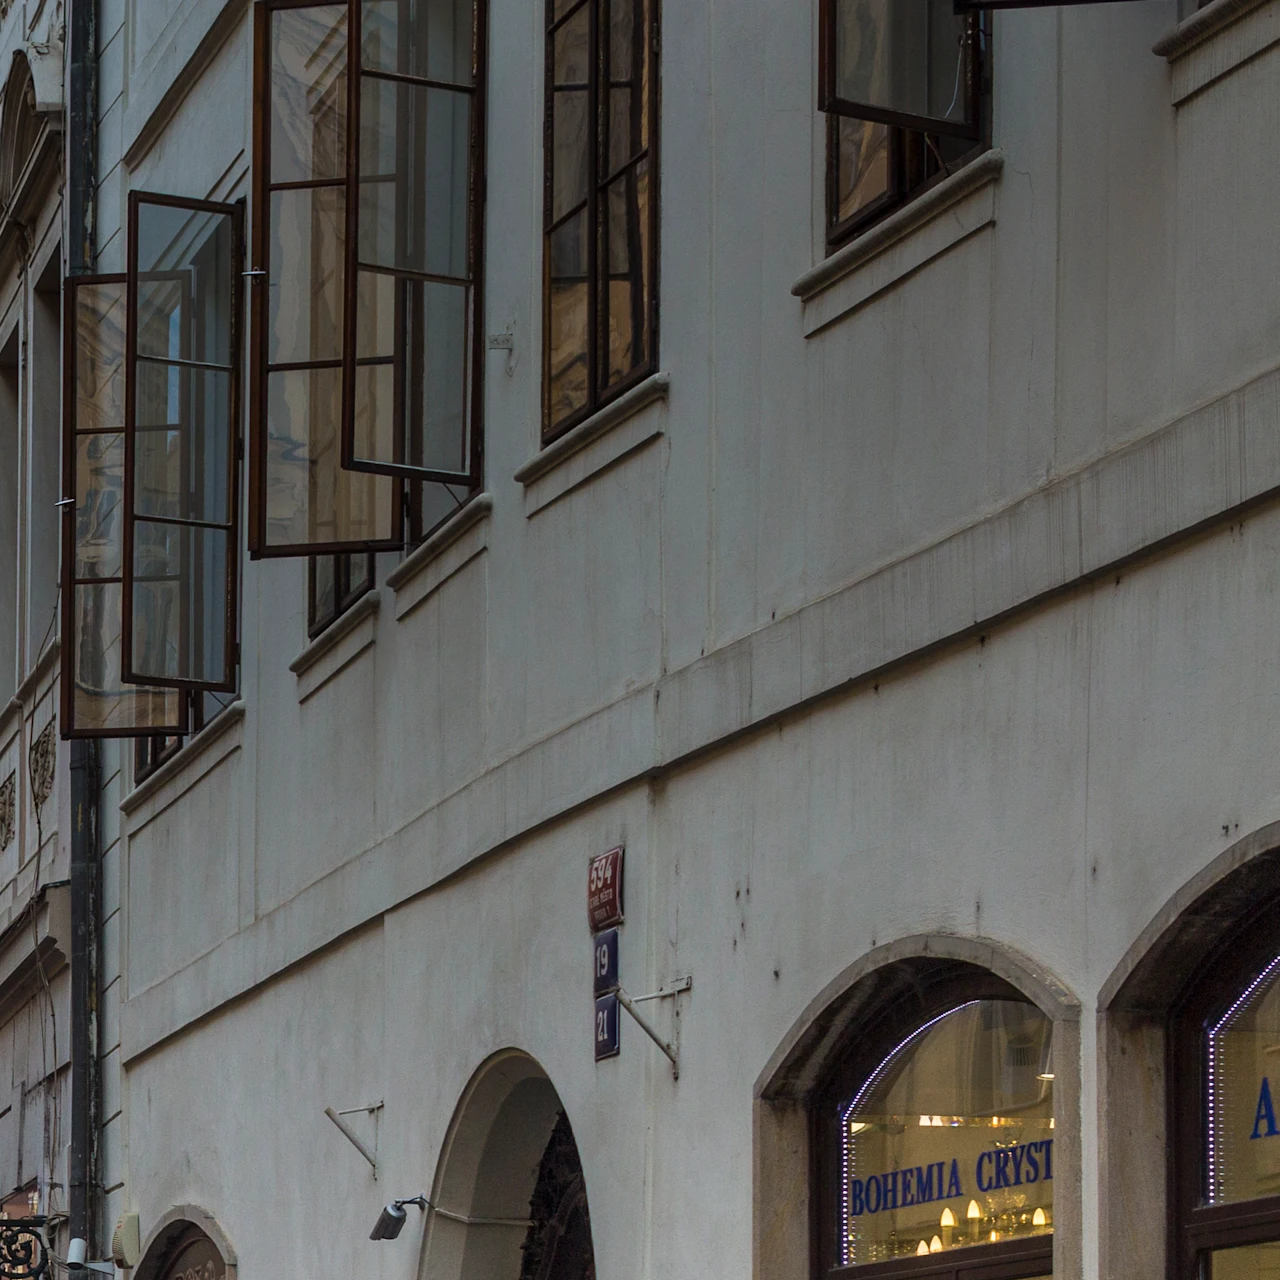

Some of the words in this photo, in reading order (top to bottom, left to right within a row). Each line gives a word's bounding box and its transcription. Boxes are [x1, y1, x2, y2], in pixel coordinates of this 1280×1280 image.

[590, 855, 613, 892] 594
[596, 944, 609, 978] 19
[597, 1009, 608, 1042] 21
[850, 1157, 963, 1217] BOHEMIA
[976, 1138, 1053, 1193] CRYST
